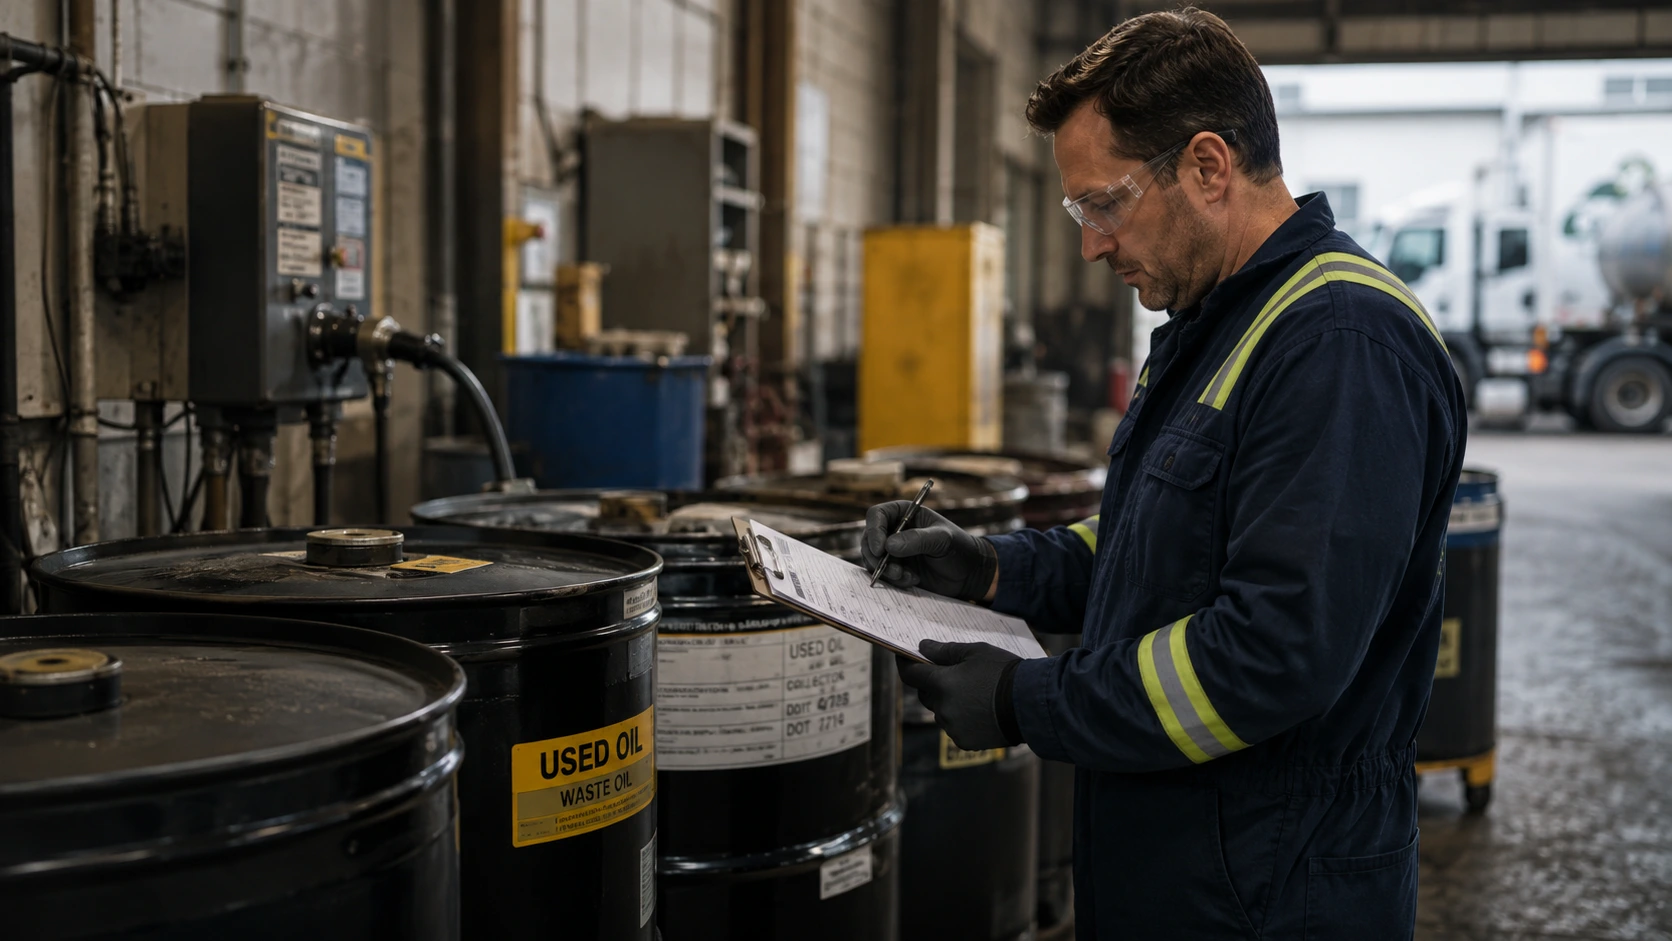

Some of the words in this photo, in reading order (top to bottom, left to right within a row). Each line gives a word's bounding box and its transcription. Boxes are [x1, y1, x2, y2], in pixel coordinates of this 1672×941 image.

[789, 640, 824, 659] USED
[786, 720, 811, 737] DOT
[540, 739, 610, 780] USED
[616, 726, 643, 760] OIL
[560, 778, 611, 808] WASTE
[614, 770, 633, 792] OIL
